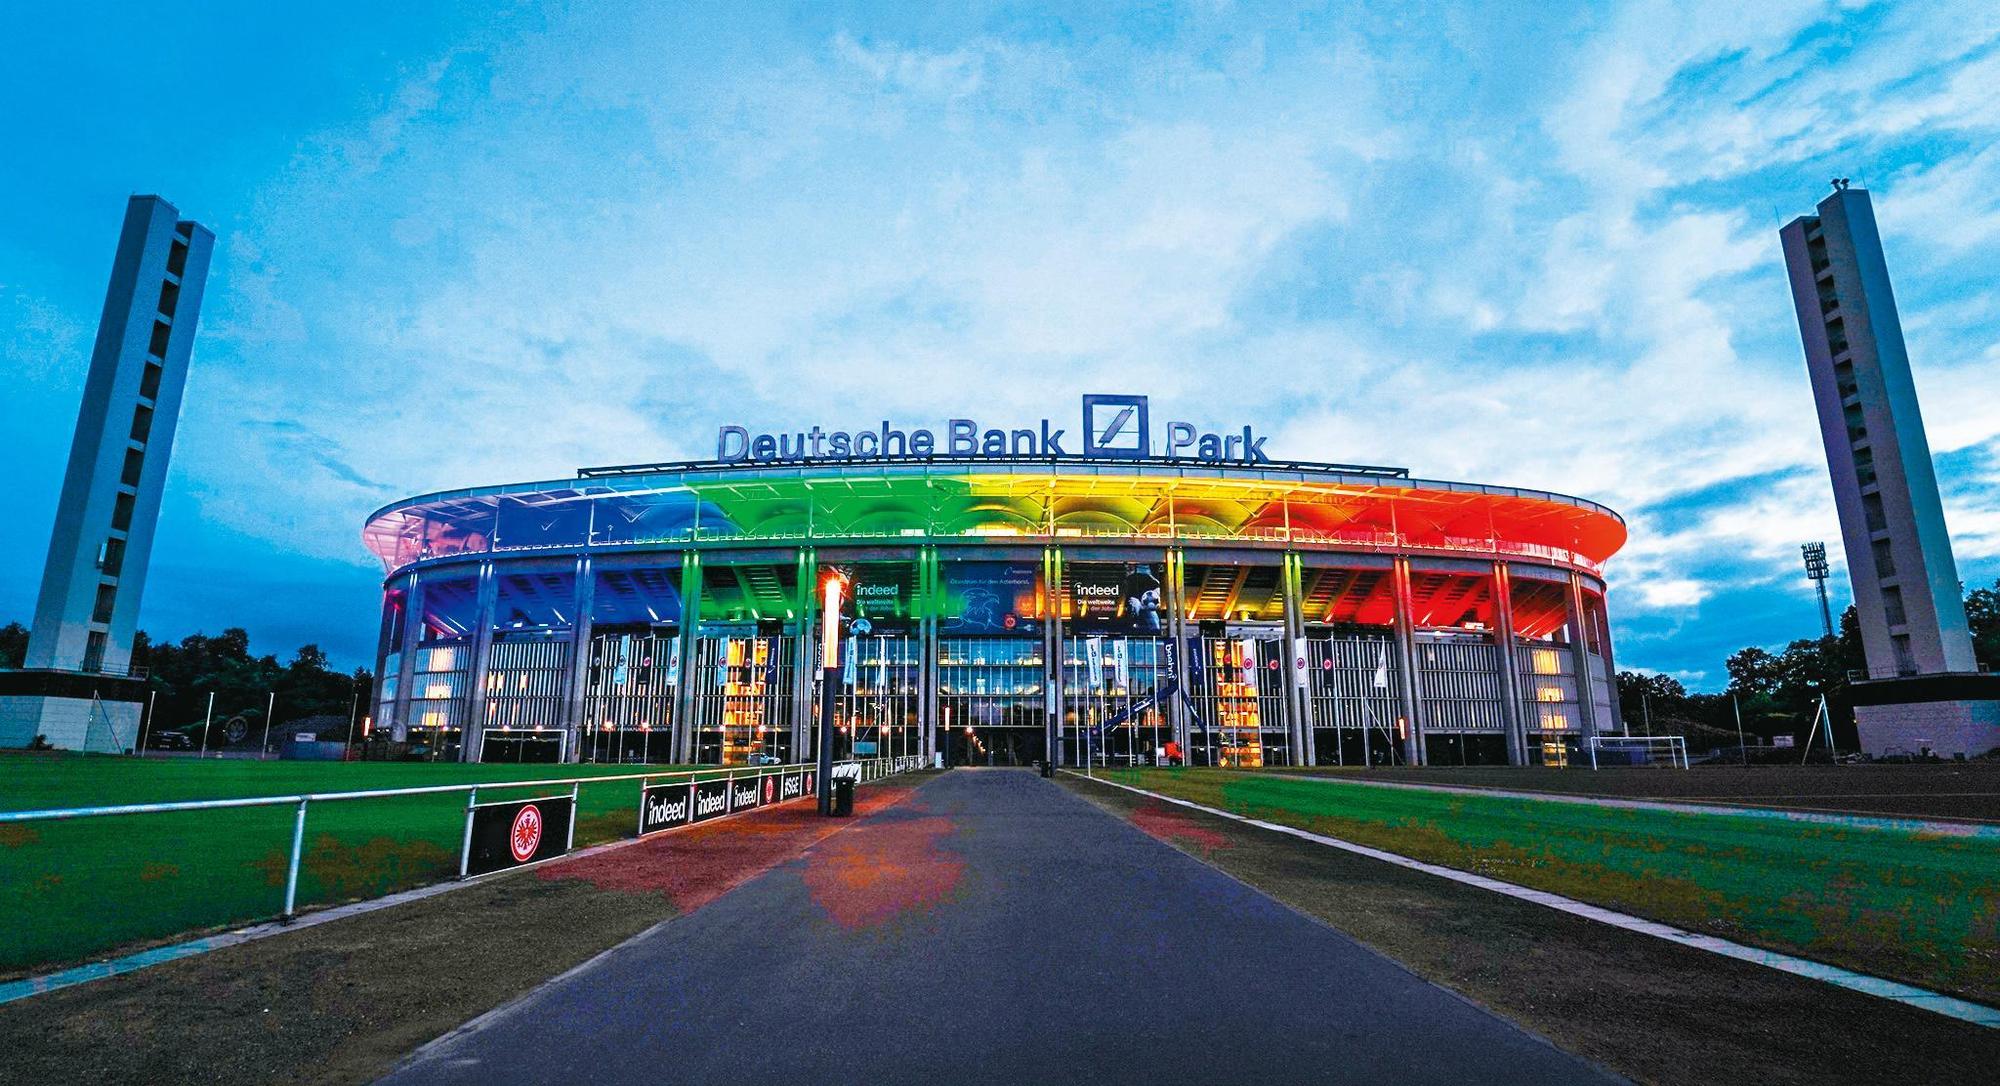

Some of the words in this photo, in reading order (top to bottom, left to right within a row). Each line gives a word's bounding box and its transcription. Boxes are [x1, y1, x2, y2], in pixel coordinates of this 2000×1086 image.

[718, 420, 935, 463] Deutsche
[948, 418, 1066, 458] Bank
[1166, 421, 1270, 463] Park
[854, 582, 899, 596] indeed
[1074, 582, 1119, 595] indeed
[734, 784, 757, 808] indeed
[784, 776, 800, 796] #SGE
[648, 795, 687, 825] indeed
[697, 789, 726, 816] indeed
